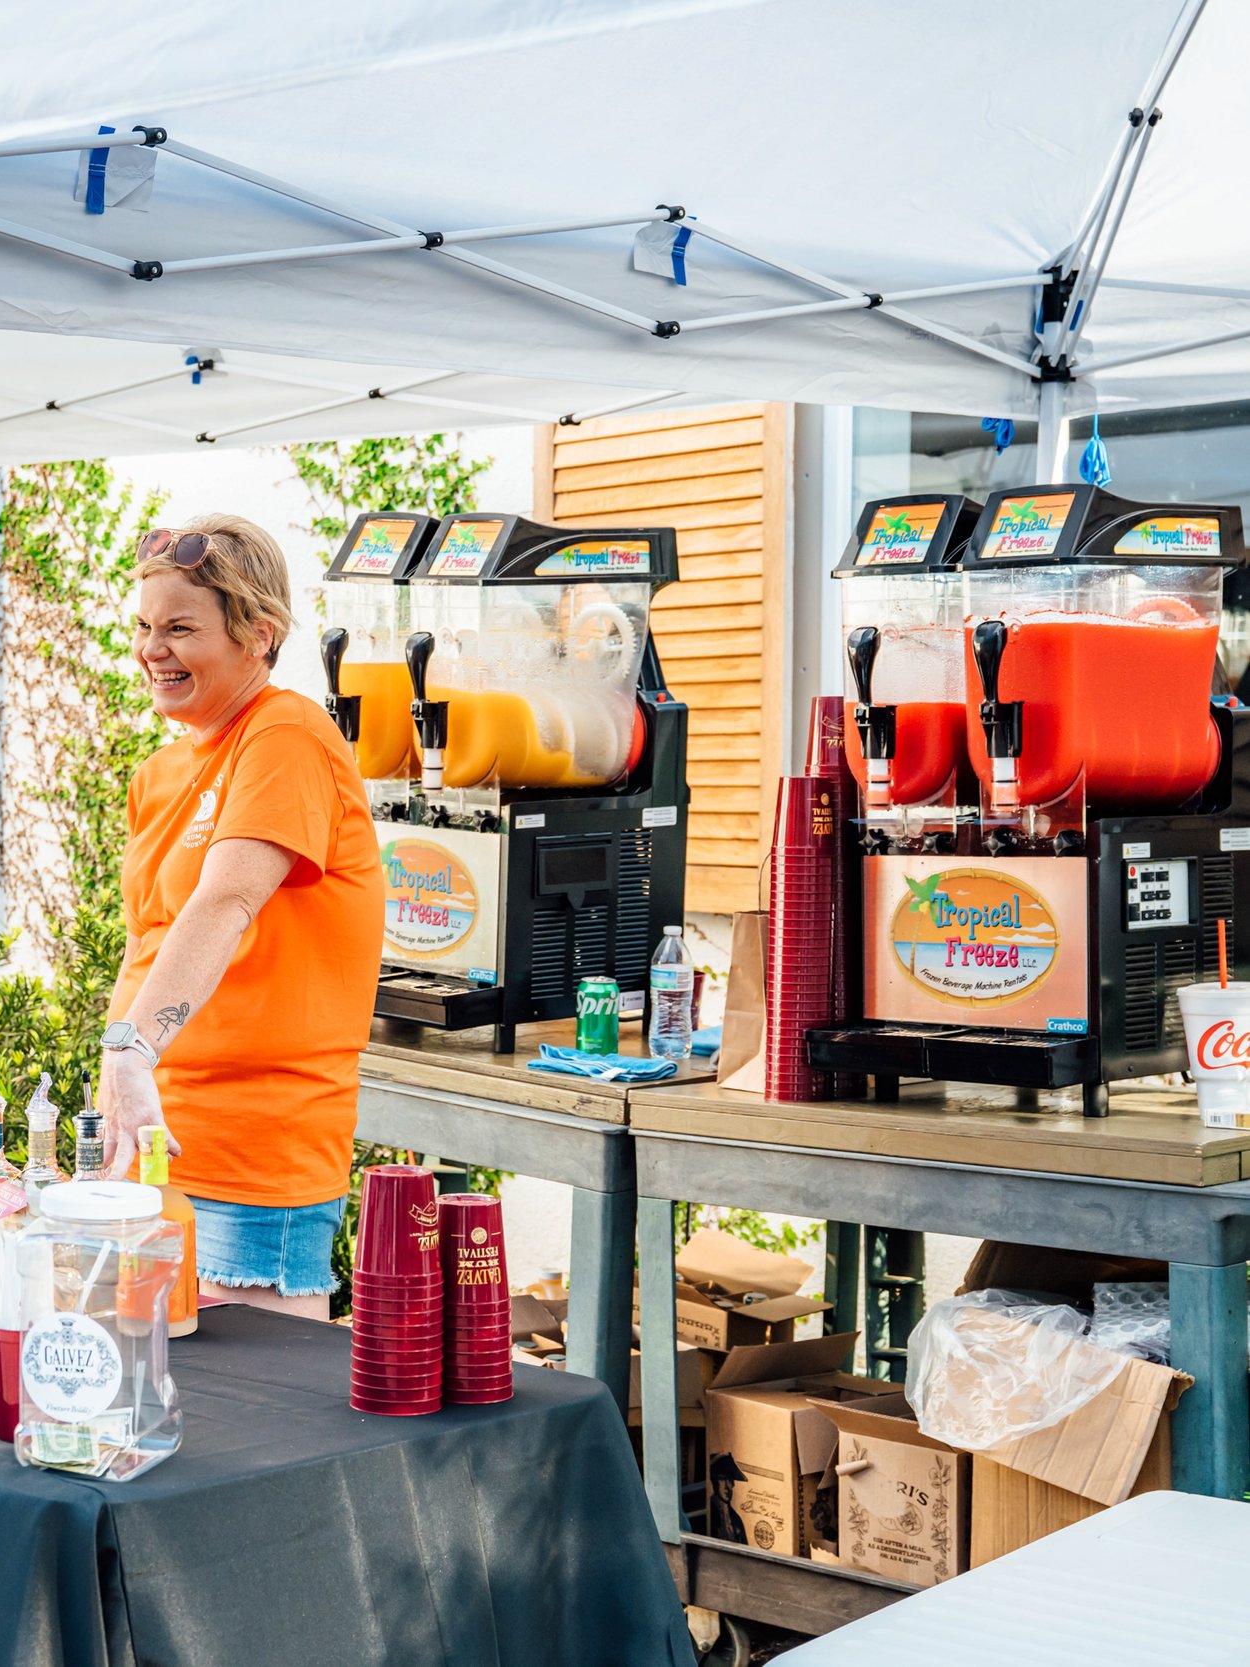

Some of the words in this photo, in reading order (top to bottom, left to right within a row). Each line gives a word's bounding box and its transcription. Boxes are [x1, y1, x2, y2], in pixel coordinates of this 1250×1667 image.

[996, 513, 1052, 538] Tropical
[871, 525, 924, 549] Tropical
[997, 535, 1045, 551] Freeze
[1150, 524, 1183, 552] Tropical
[1185, 527, 1212, 546] Freeze
[357, 538, 398, 558] Tropical
[444, 538, 485, 558] Tropical
[871, 546, 916, 561] Freeze
[355, 555, 388, 568] Freeze
[443, 555, 476, 568] Freeze
[573, 548, 609, 572] Tropical
[611, 549, 640, 566] Freeze
[387, 857, 452, 901] Tropical
[397, 896, 449, 927] Freeze
[930, 893, 1022, 940] Tropical
[920, 968, 942, 983] Frozen
[942, 977, 972, 992] Beverage
[974, 981, 1002, 990] Machine
[1048, 1021, 1085, 1033] Crathco
[456, 1246, 499, 1258] FESTIVAL
[458, 1259, 499, 1268] RUM
[456, 1266, 502, 1285] GALVEZ
[44, 1345, 94, 1368] GALVEZ
